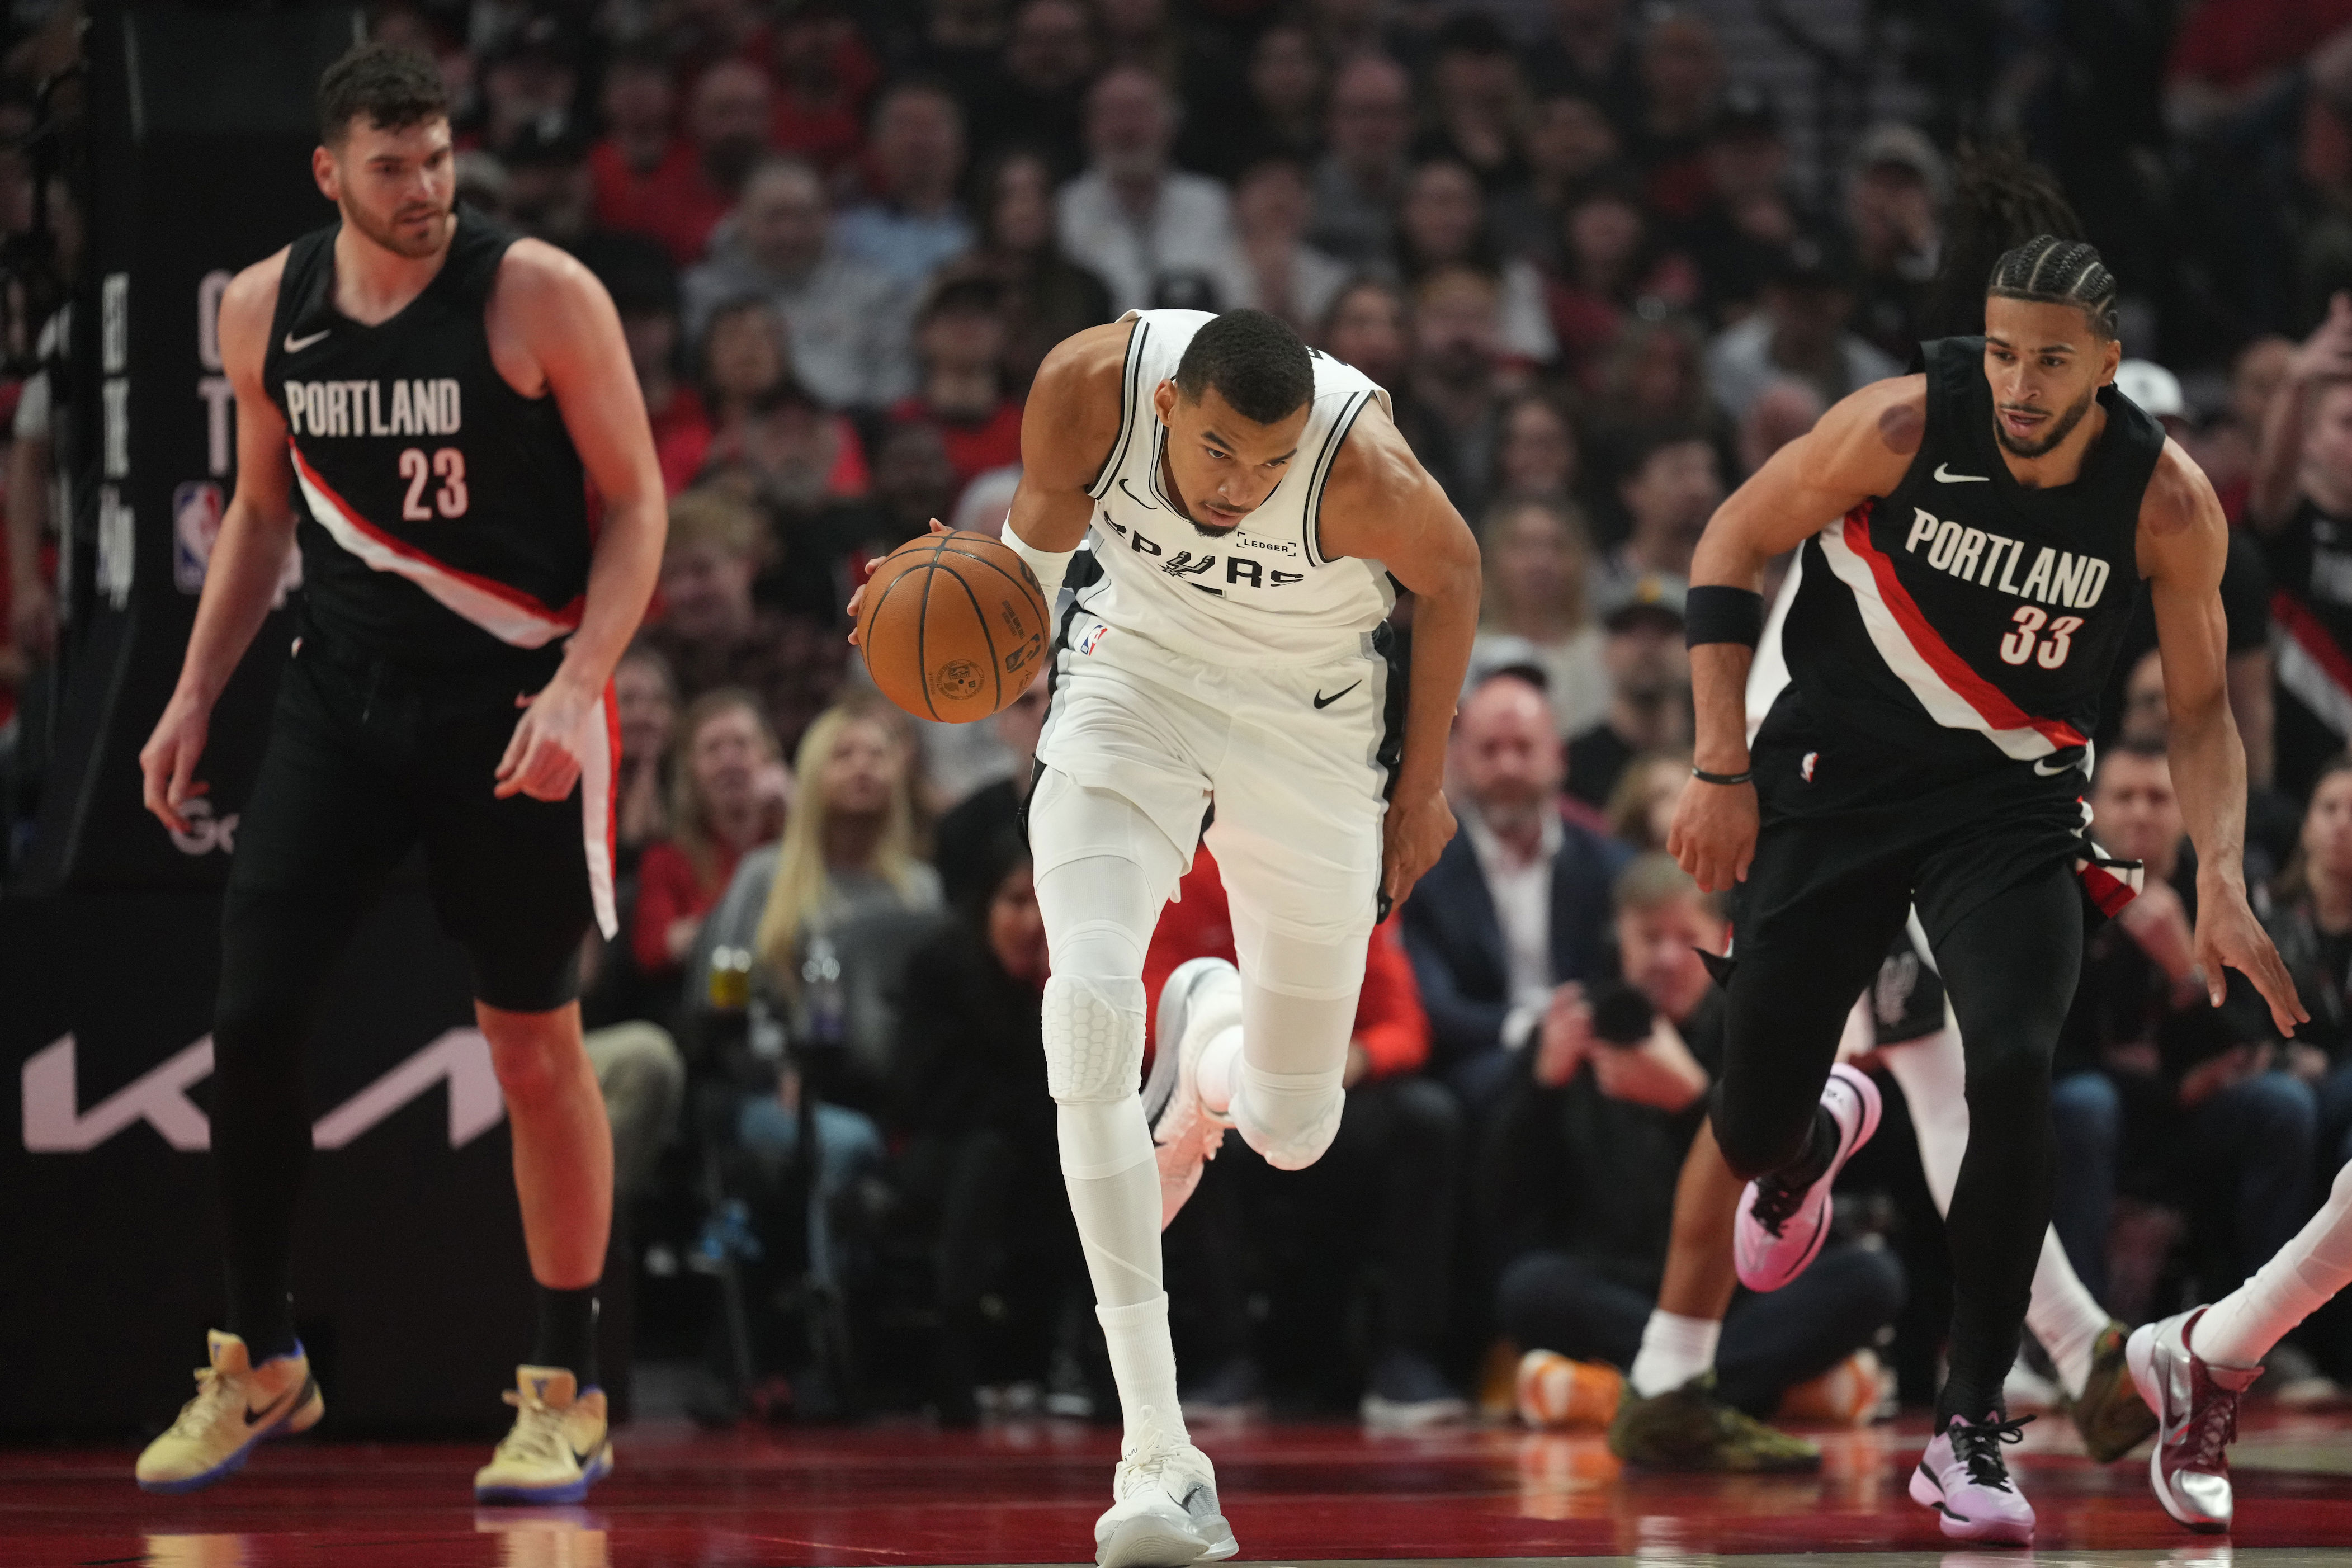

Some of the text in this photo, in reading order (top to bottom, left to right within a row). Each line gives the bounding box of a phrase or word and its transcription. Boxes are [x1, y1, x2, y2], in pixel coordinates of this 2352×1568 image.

[284, 378, 461, 437] PORTLAND
[399, 447, 469, 521] 23
[1244, 539, 1288, 552] LEDGER
[1906, 507, 2110, 608] PORTLAND
[2000, 606, 2084, 669] 33
[21, 1029, 507, 1153] KA
